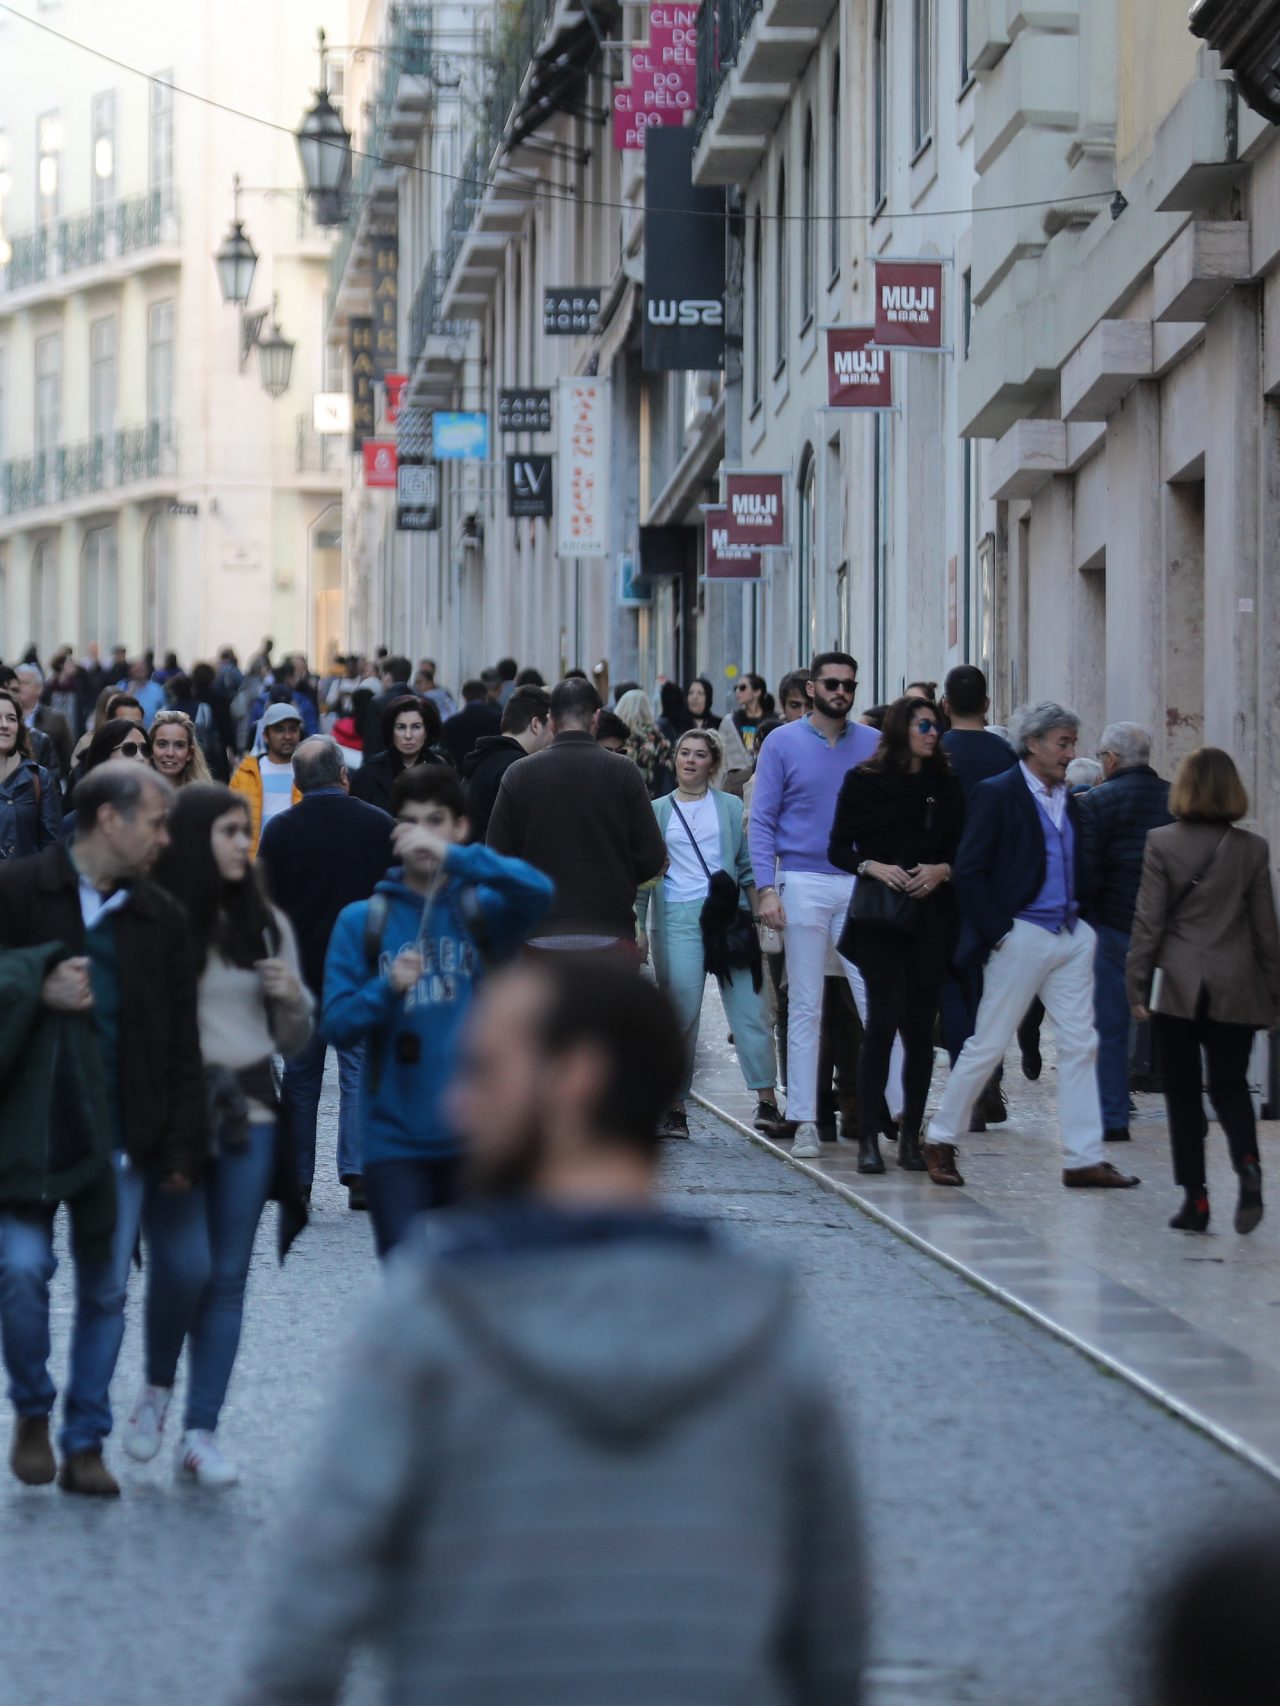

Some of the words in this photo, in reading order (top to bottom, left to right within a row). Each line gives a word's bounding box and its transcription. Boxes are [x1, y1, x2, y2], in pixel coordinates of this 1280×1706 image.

[654, 73, 680, 90] DO
[635, 112, 661, 128] DO
[543, 297, 599, 312] ZARA
[882, 286, 935, 310] MUJI
[543, 314, 599, 329] HOME
[834, 350, 885, 373] MUJI
[500, 397, 549, 412] ZARA
[499, 412, 549, 427] HOME
[732, 494, 777, 515] MUJI
